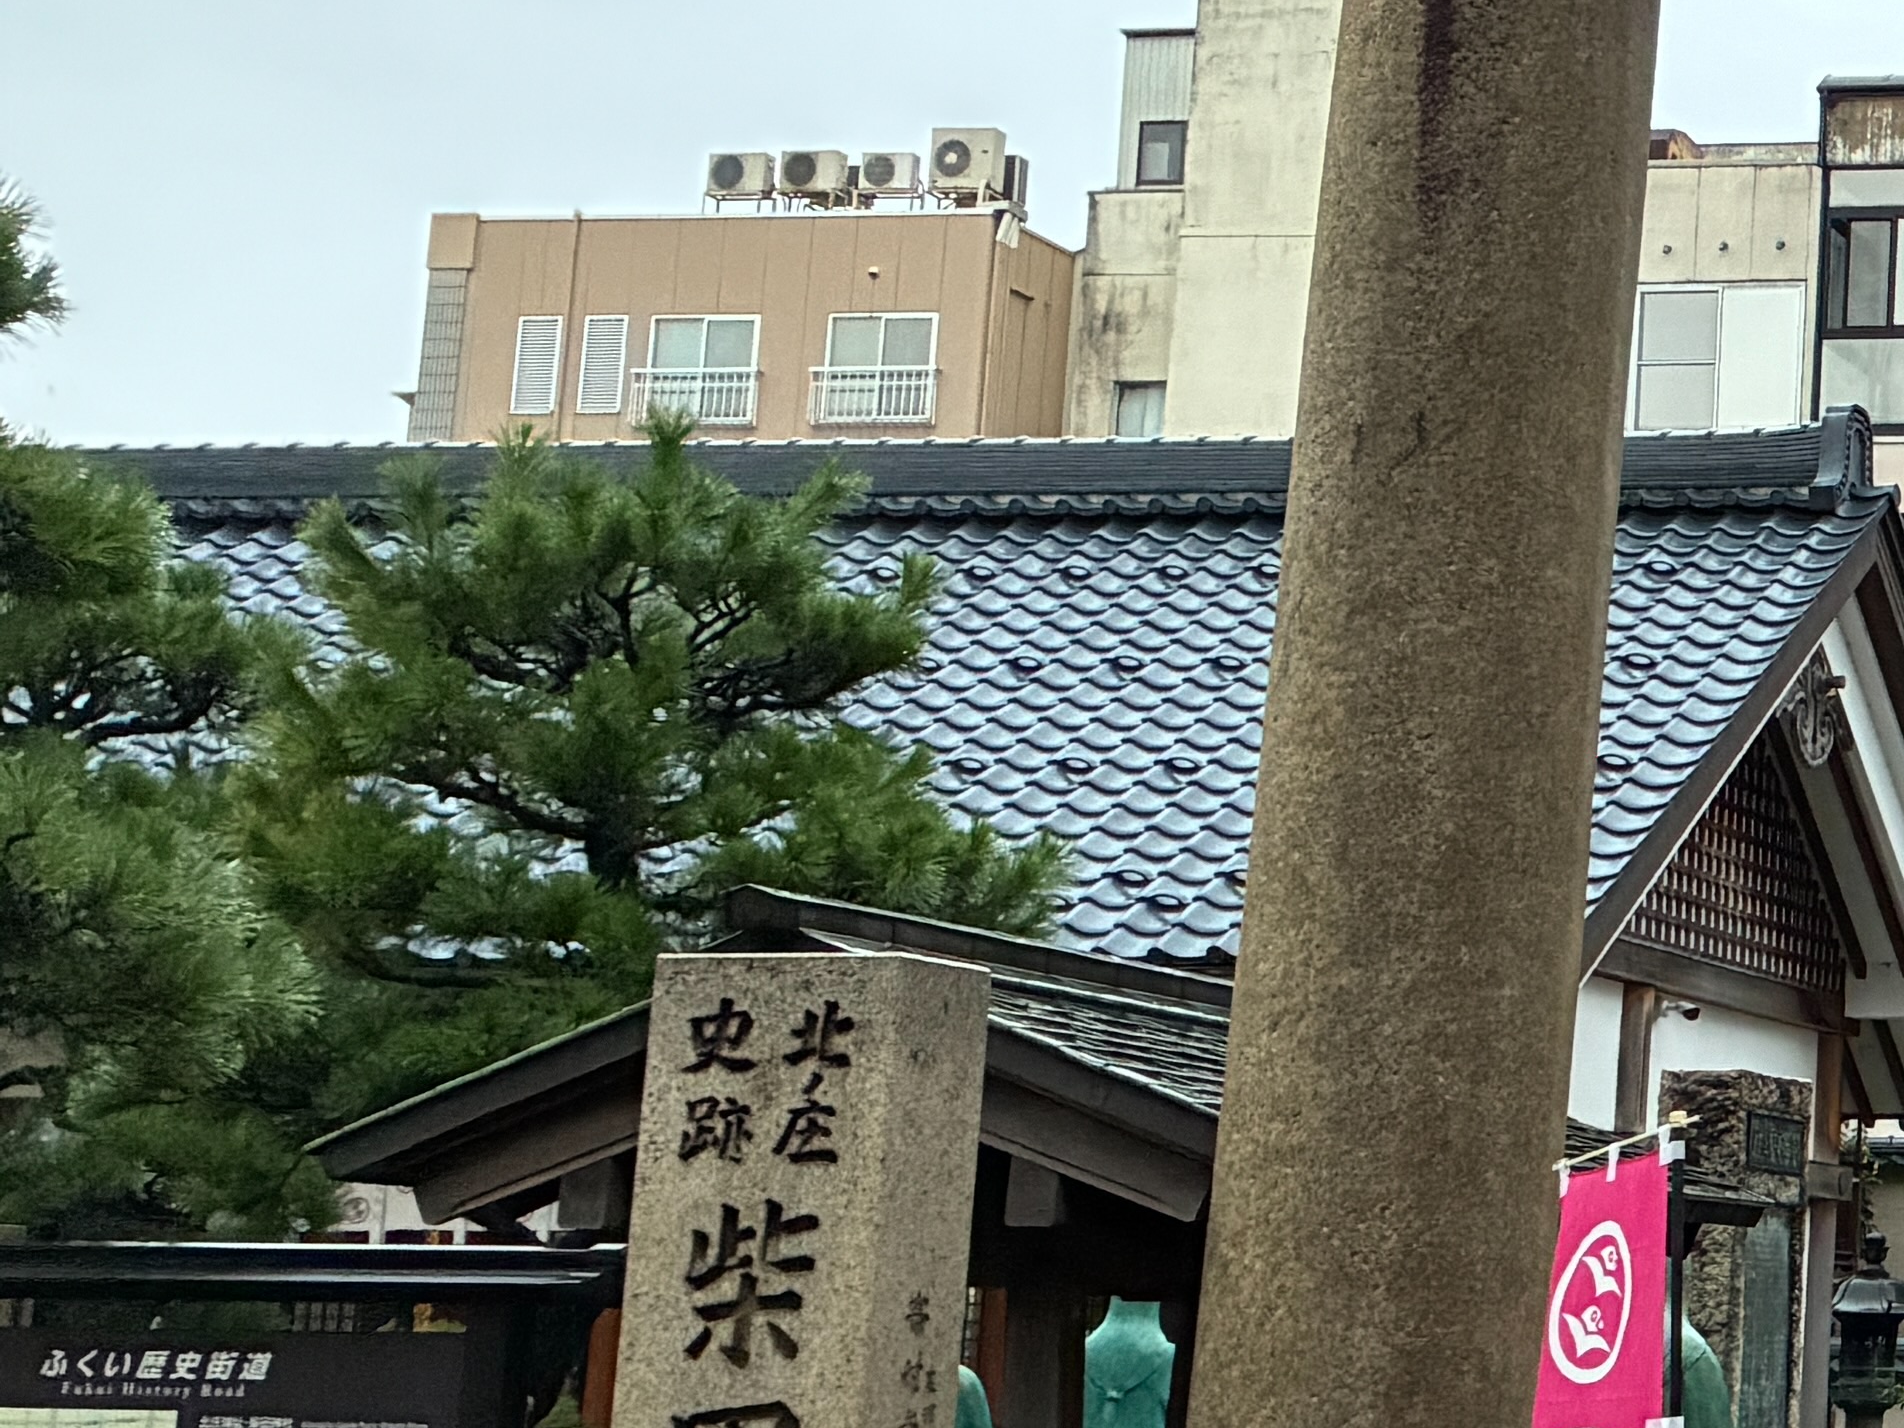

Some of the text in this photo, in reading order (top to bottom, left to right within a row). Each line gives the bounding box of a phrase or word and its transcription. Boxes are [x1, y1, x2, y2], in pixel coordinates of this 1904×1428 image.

[677, 997, 757, 1164] 史跡
[772, 999, 855, 1164] 北ノ庄
[38, 1348, 273, 1382] ふくい歴史街道
